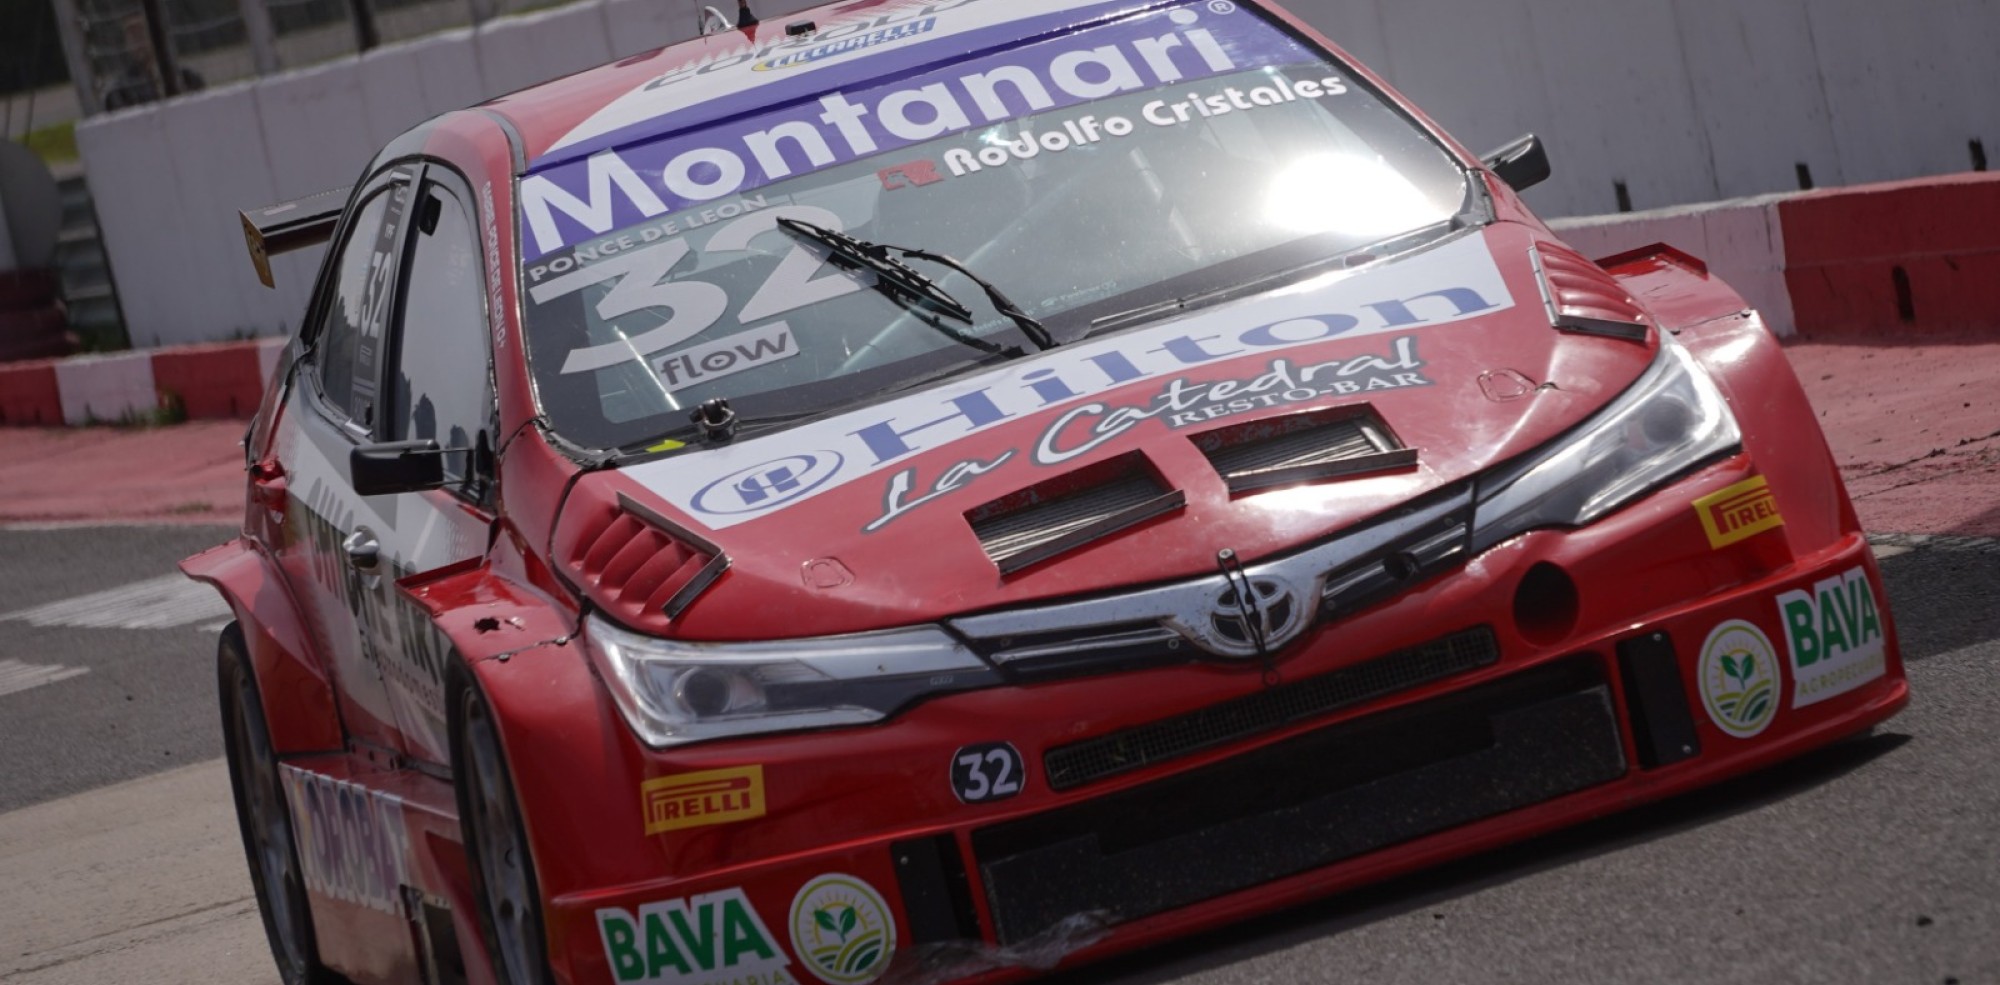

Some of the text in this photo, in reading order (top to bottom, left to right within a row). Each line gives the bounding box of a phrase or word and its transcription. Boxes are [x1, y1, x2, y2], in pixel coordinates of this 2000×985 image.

[643, 0, 978, 92] COROLL
[521, 8, 1236, 254] Montanari
[943, 115, 1134, 177] Rodolfo
[1142, 74, 1348, 127] Cristales
[529, 193, 769, 282] PONCE DE LEON
[529, 205, 868, 375] 32
[660, 332, 788, 386] flow
[845, 284, 1502, 467] Hilton
[1168, 372, 1430, 429] RESTO-BAR
[866, 336, 1421, 532] La Catedral
[1708, 484, 1777, 536] PIREL
[1784, 576, 1881, 668] BAVA
[646, 776, 752, 825] PIRELLI
[957, 748, 1019, 801] 32
[603, 898, 776, 983] BAVA
